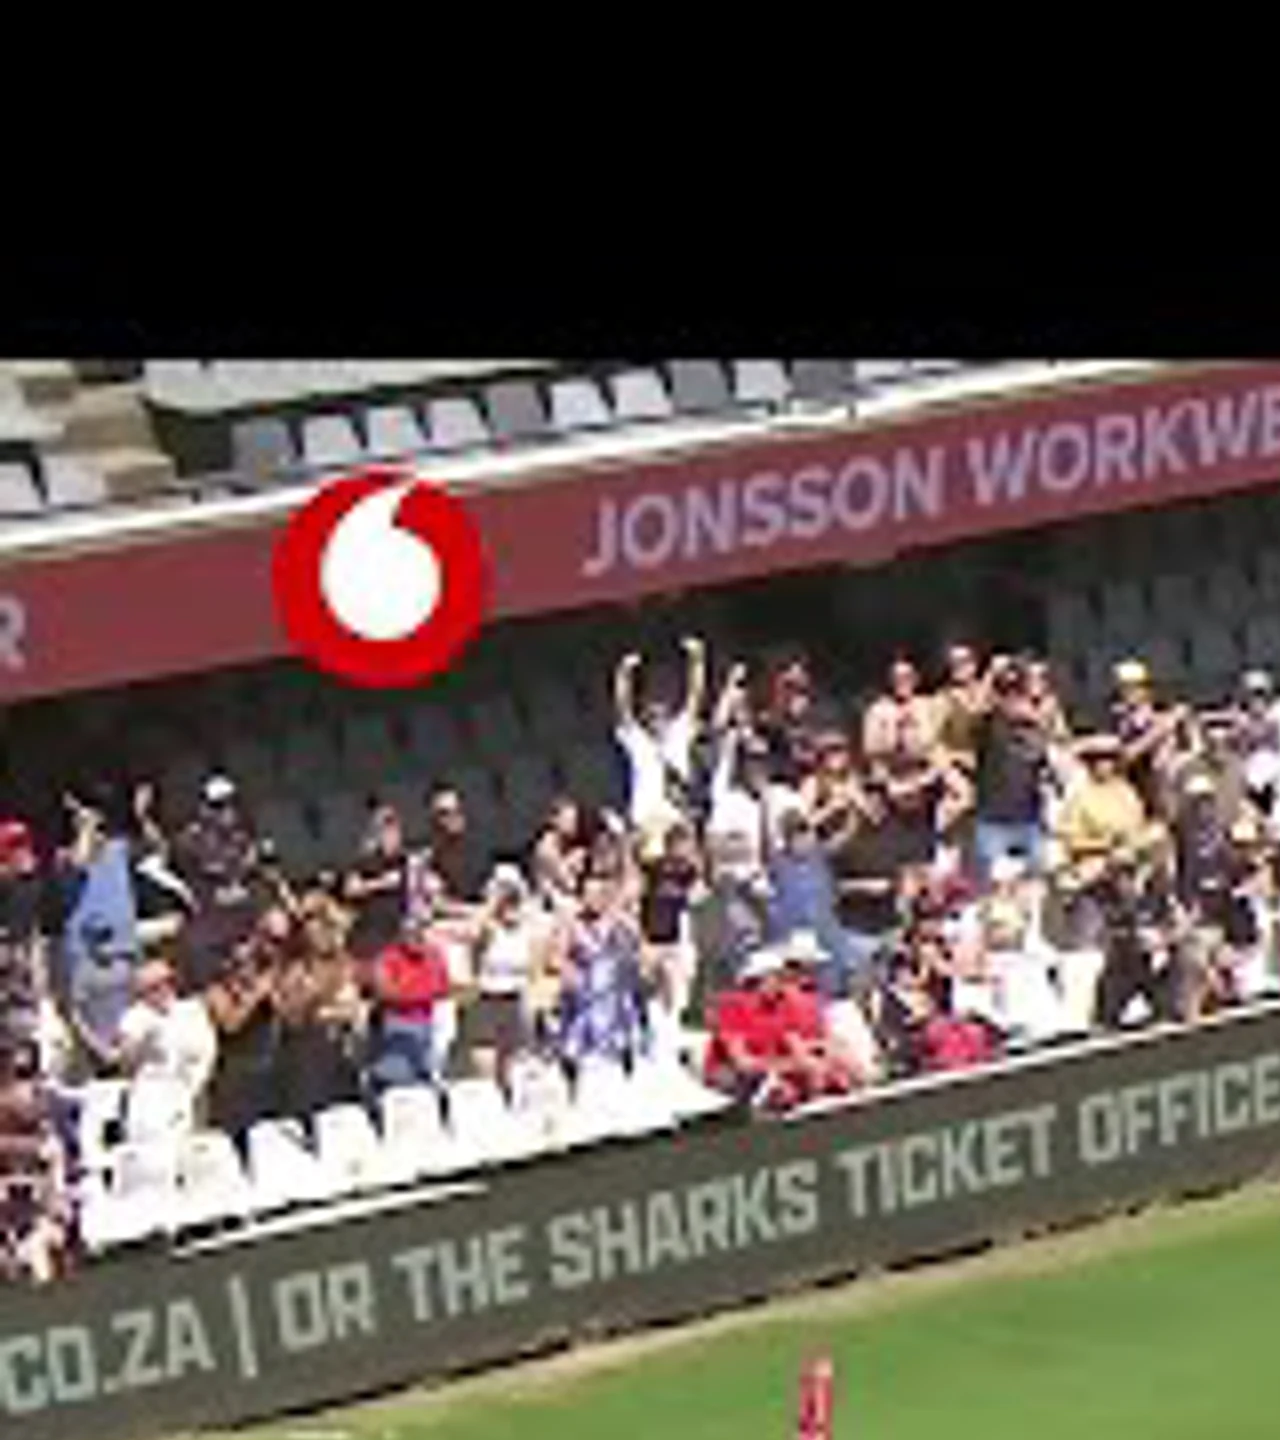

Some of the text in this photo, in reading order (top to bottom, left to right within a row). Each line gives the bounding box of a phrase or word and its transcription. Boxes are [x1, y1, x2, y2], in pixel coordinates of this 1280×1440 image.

[583, 446, 943, 577] JONSSON
[272, 1261, 377, 1350] OR
[391, 1228, 530, 1321] THE
[545, 1159, 819, 1288] SHARKS
[837, 1104, 1058, 1220] TICKET
